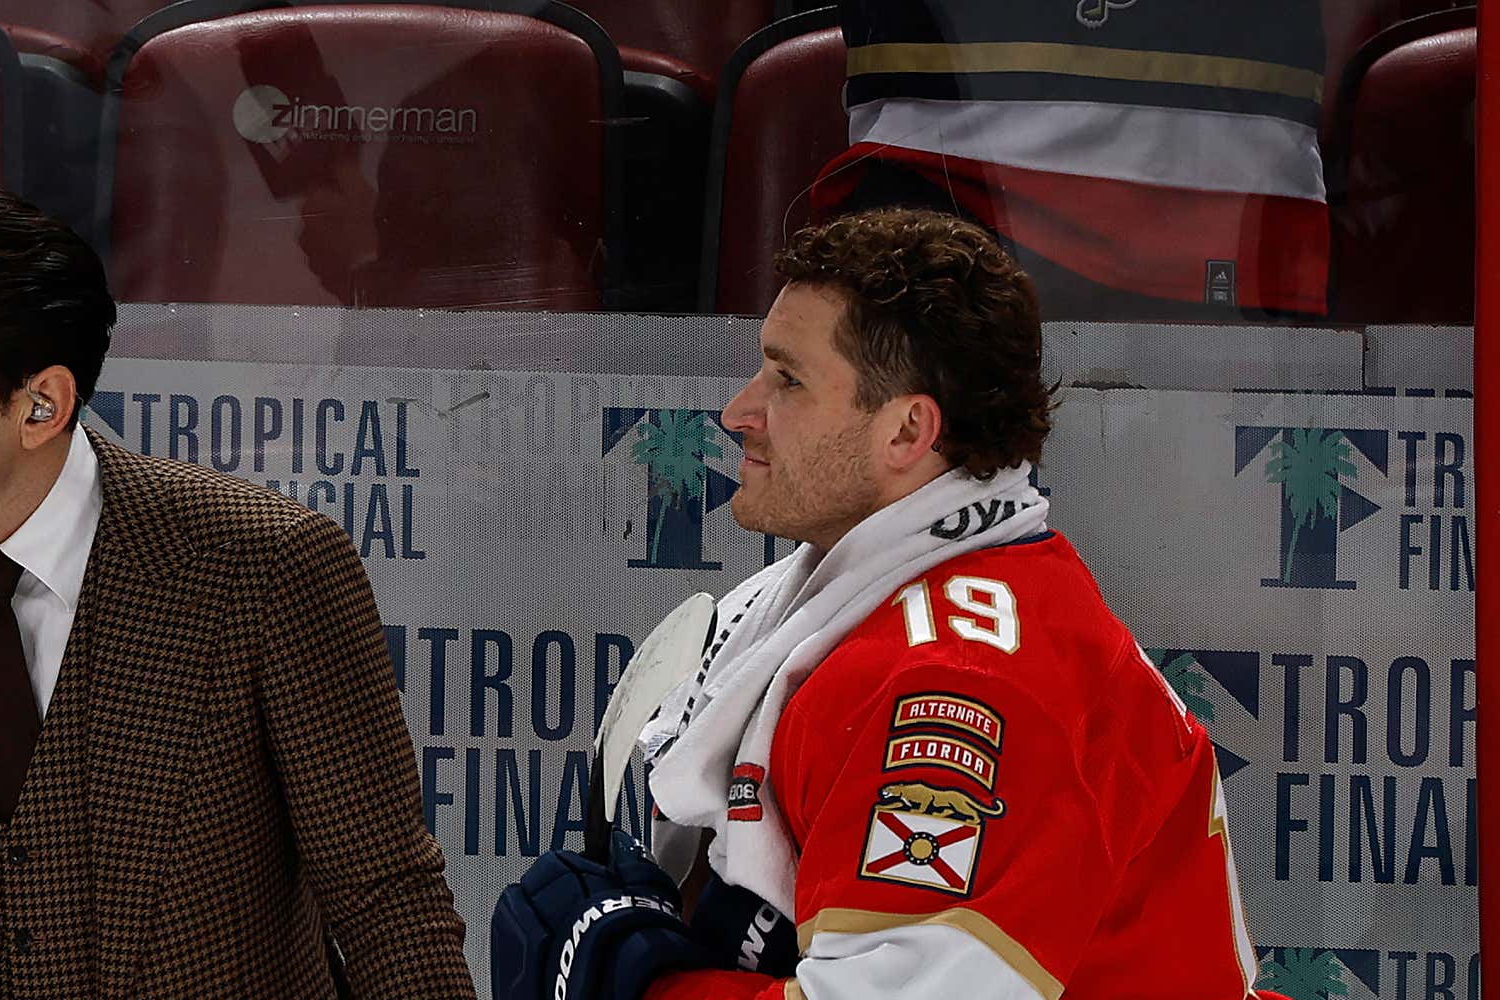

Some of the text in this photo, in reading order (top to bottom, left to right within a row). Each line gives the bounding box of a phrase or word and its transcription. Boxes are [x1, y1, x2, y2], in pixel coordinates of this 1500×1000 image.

[272, 97, 477, 133] zimmerman
[133, 391, 420, 478] TROPICAL
[891, 574, 1021, 656] 19
[909, 702, 992, 734] ALTERNATE
[900, 741, 985, 775] FLORIDA
[1275, 772, 1479, 887] FINA
